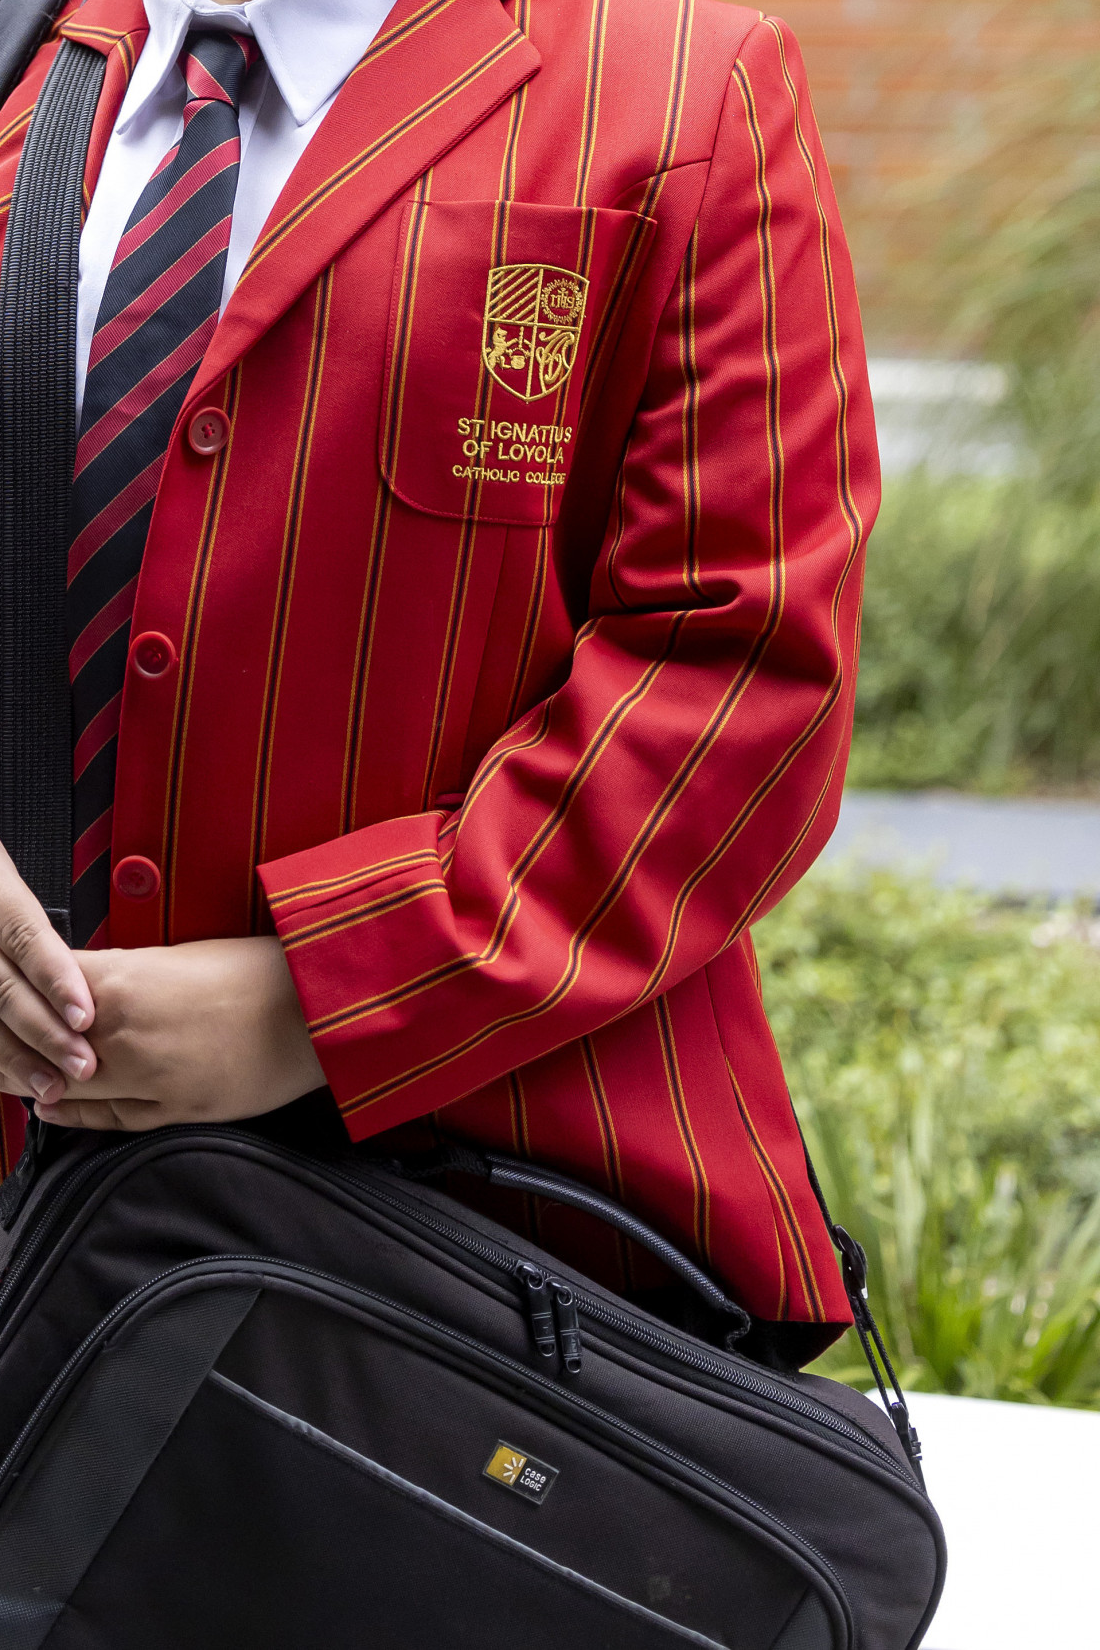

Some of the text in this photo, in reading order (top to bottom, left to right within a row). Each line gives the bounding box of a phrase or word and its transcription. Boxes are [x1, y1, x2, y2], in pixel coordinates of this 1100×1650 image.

[457, 417, 572, 443] ST IGNATIUS
[463, 439, 564, 464] OF LOYOLA
[452, 465, 566, 484] CATHOLIC COLLEGE
[520, 1475, 542, 1491] LOGIC
[525, 1468, 546, 1483] case
